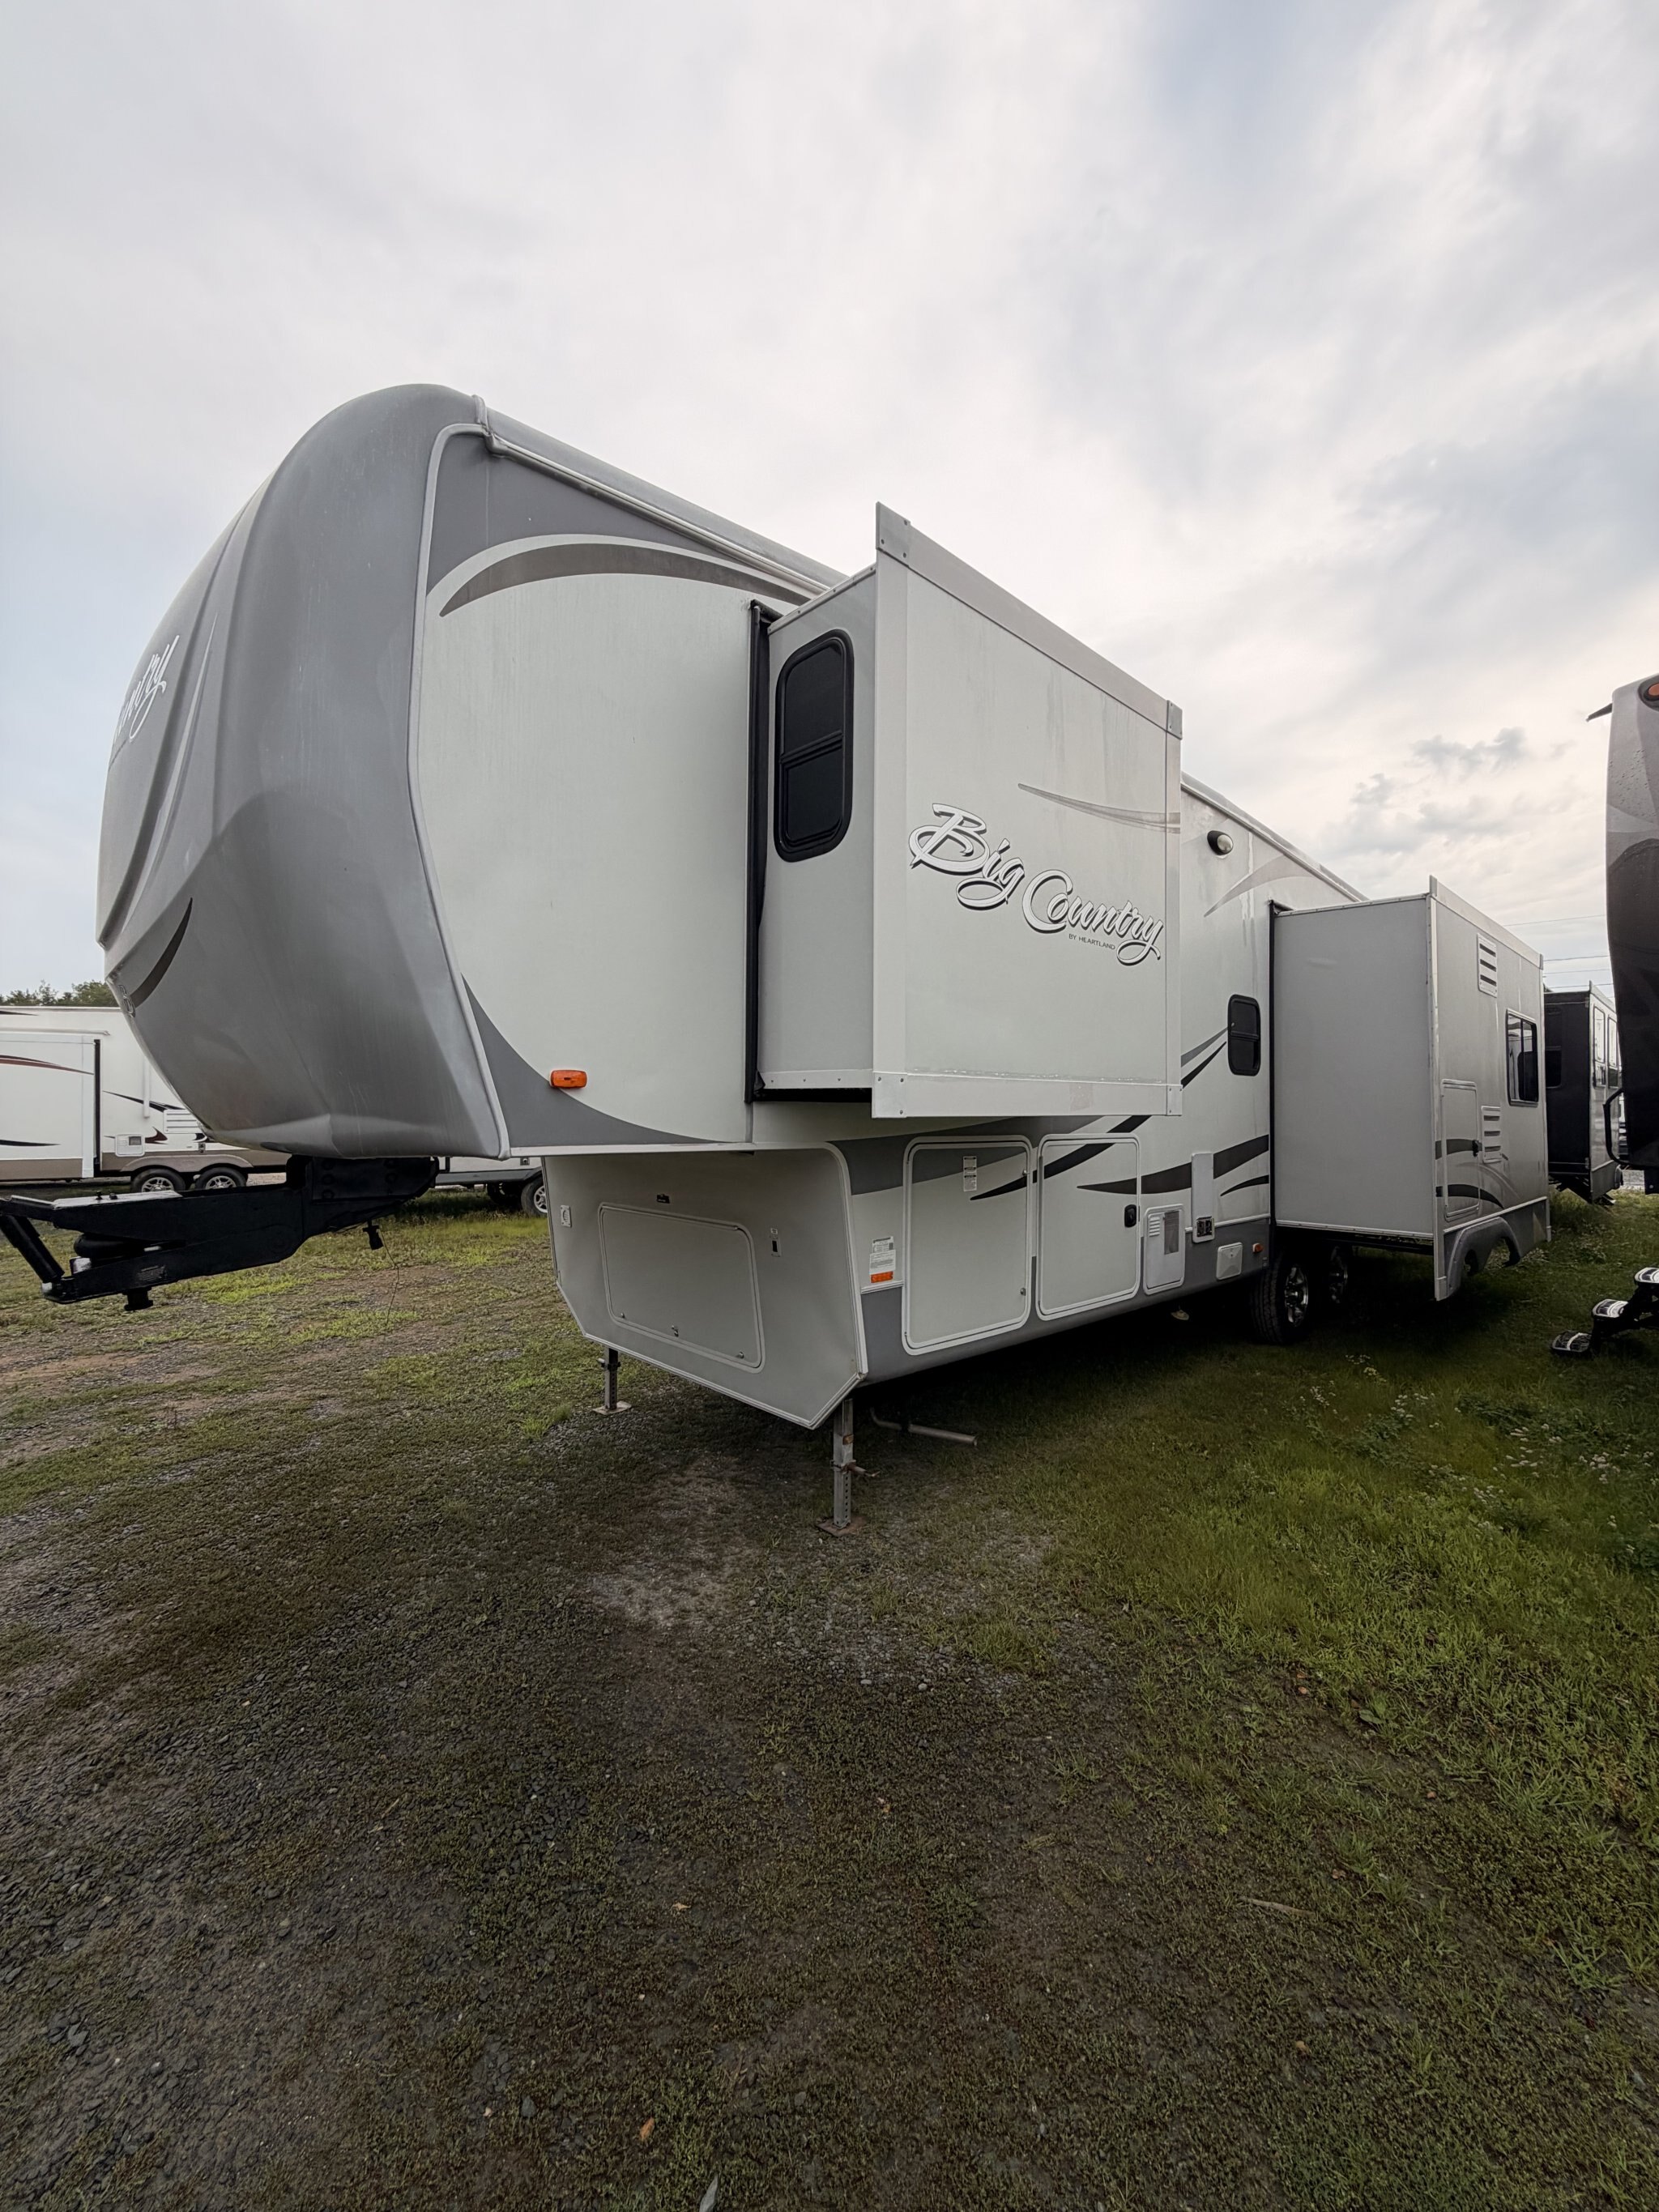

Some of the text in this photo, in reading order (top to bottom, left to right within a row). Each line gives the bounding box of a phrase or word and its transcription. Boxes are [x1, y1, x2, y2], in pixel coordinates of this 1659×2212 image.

[908, 803, 1164, 966] Big Country
[1078, 936, 1116, 950] HEARTLAND
